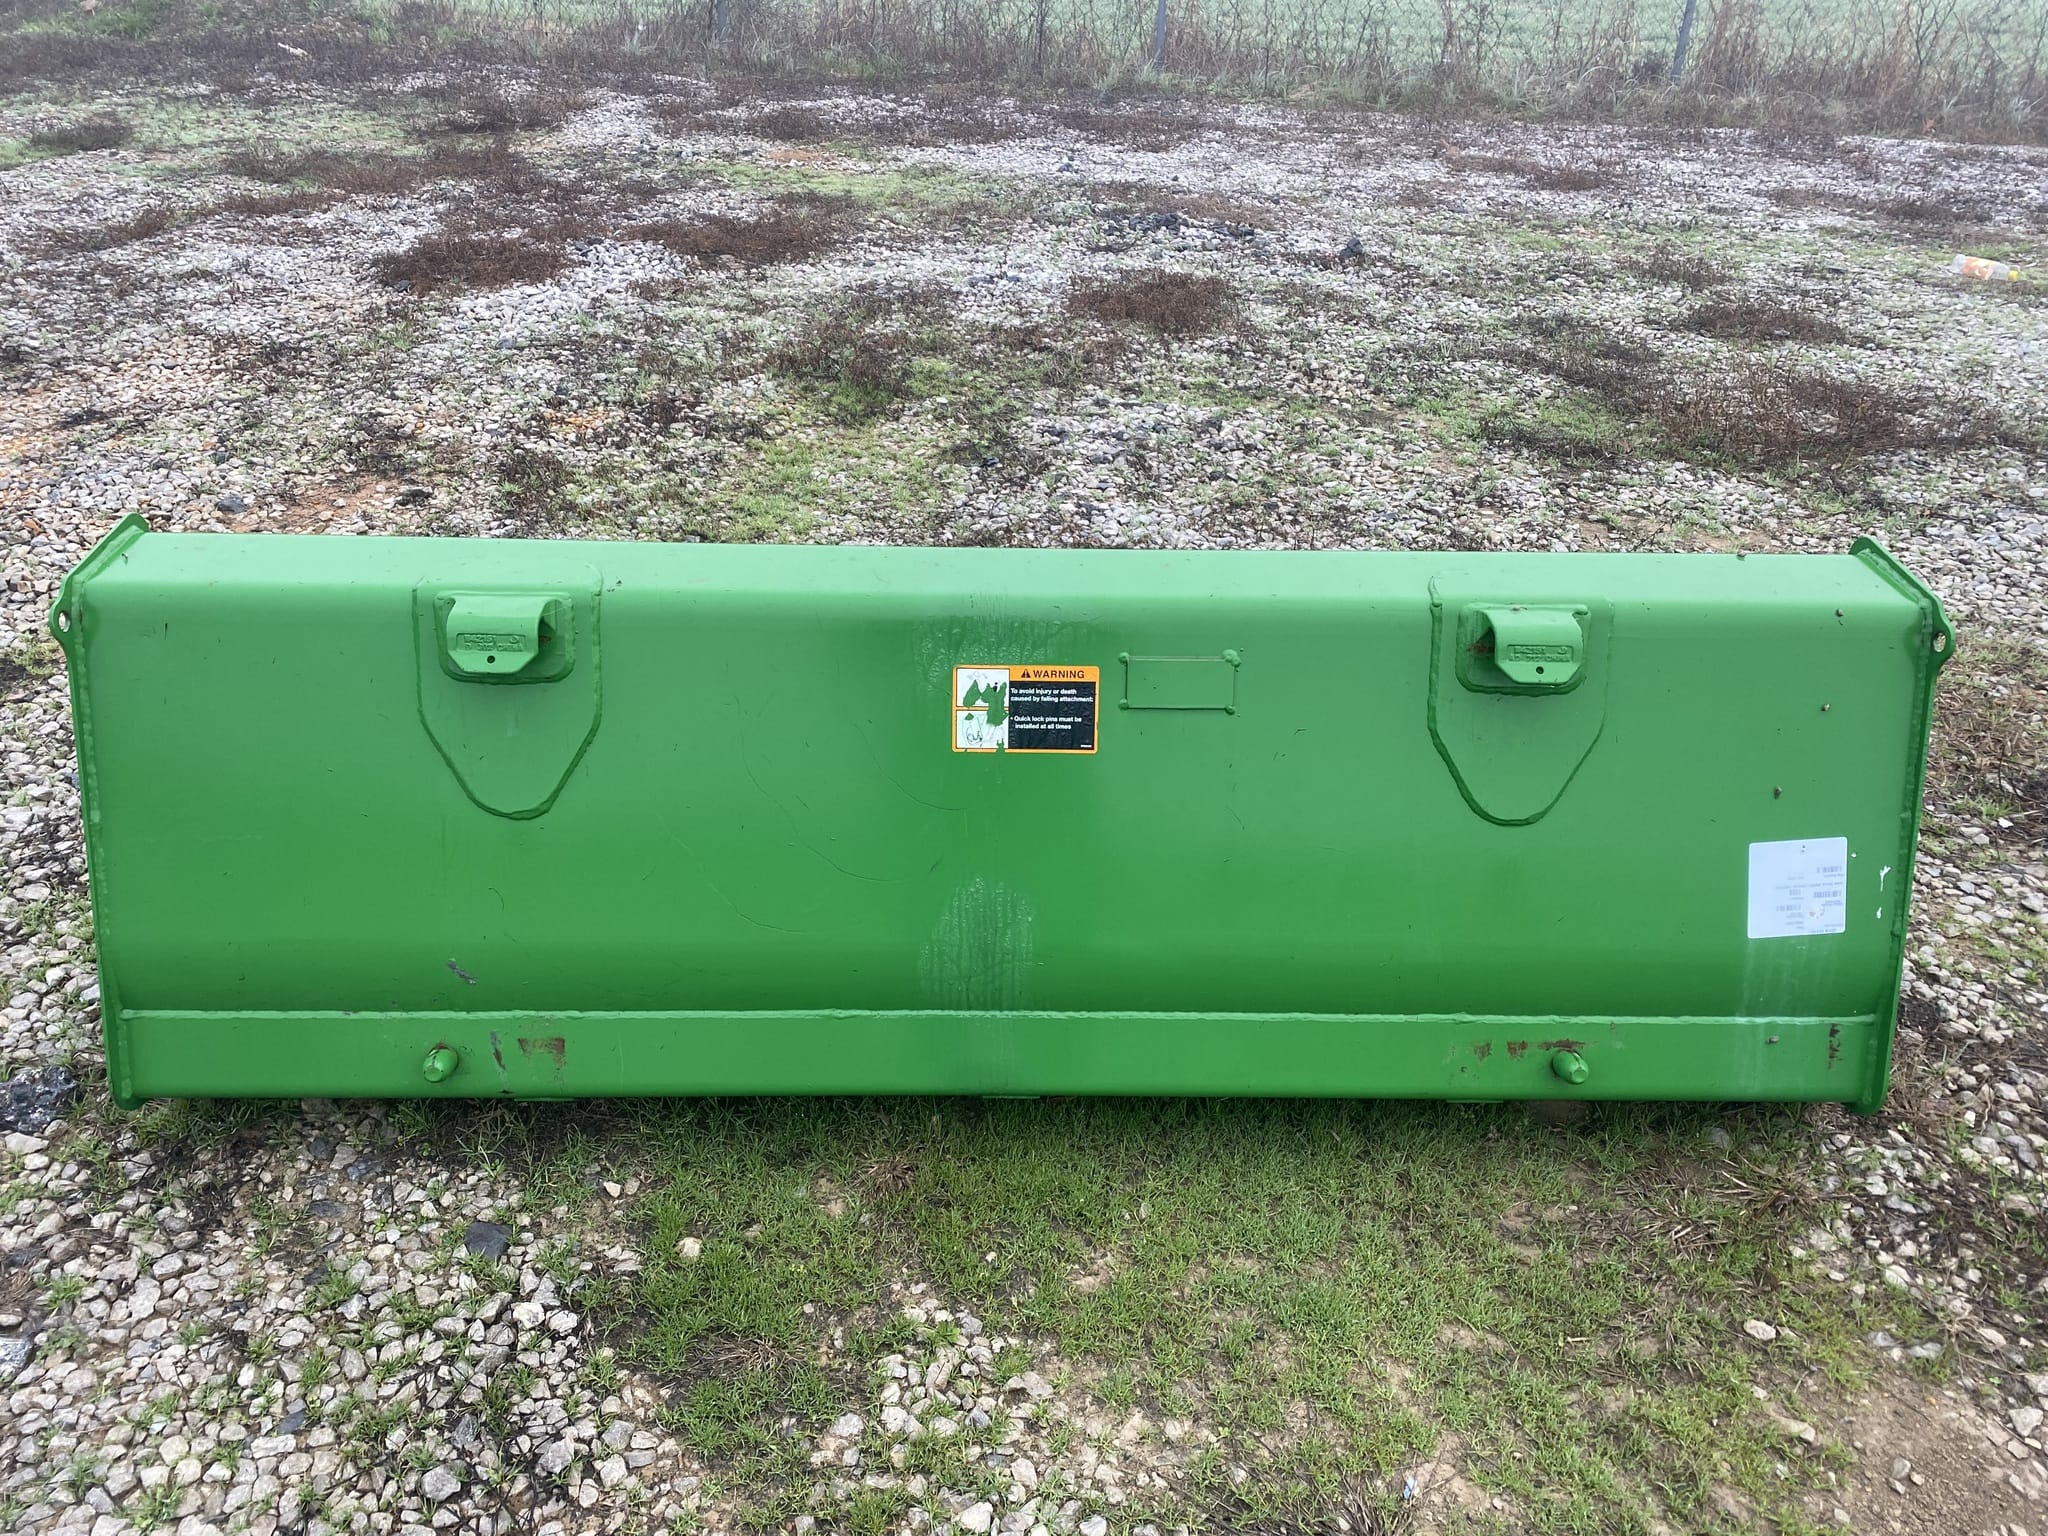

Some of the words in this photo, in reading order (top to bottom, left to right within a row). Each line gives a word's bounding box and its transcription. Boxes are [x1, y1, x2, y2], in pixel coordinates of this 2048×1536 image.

[1033, 670, 1085, 679] WARNING
[1035, 688, 1052, 696] injury
[1032, 695, 1040, 703] by
[1041, 695, 1059, 703] falling
